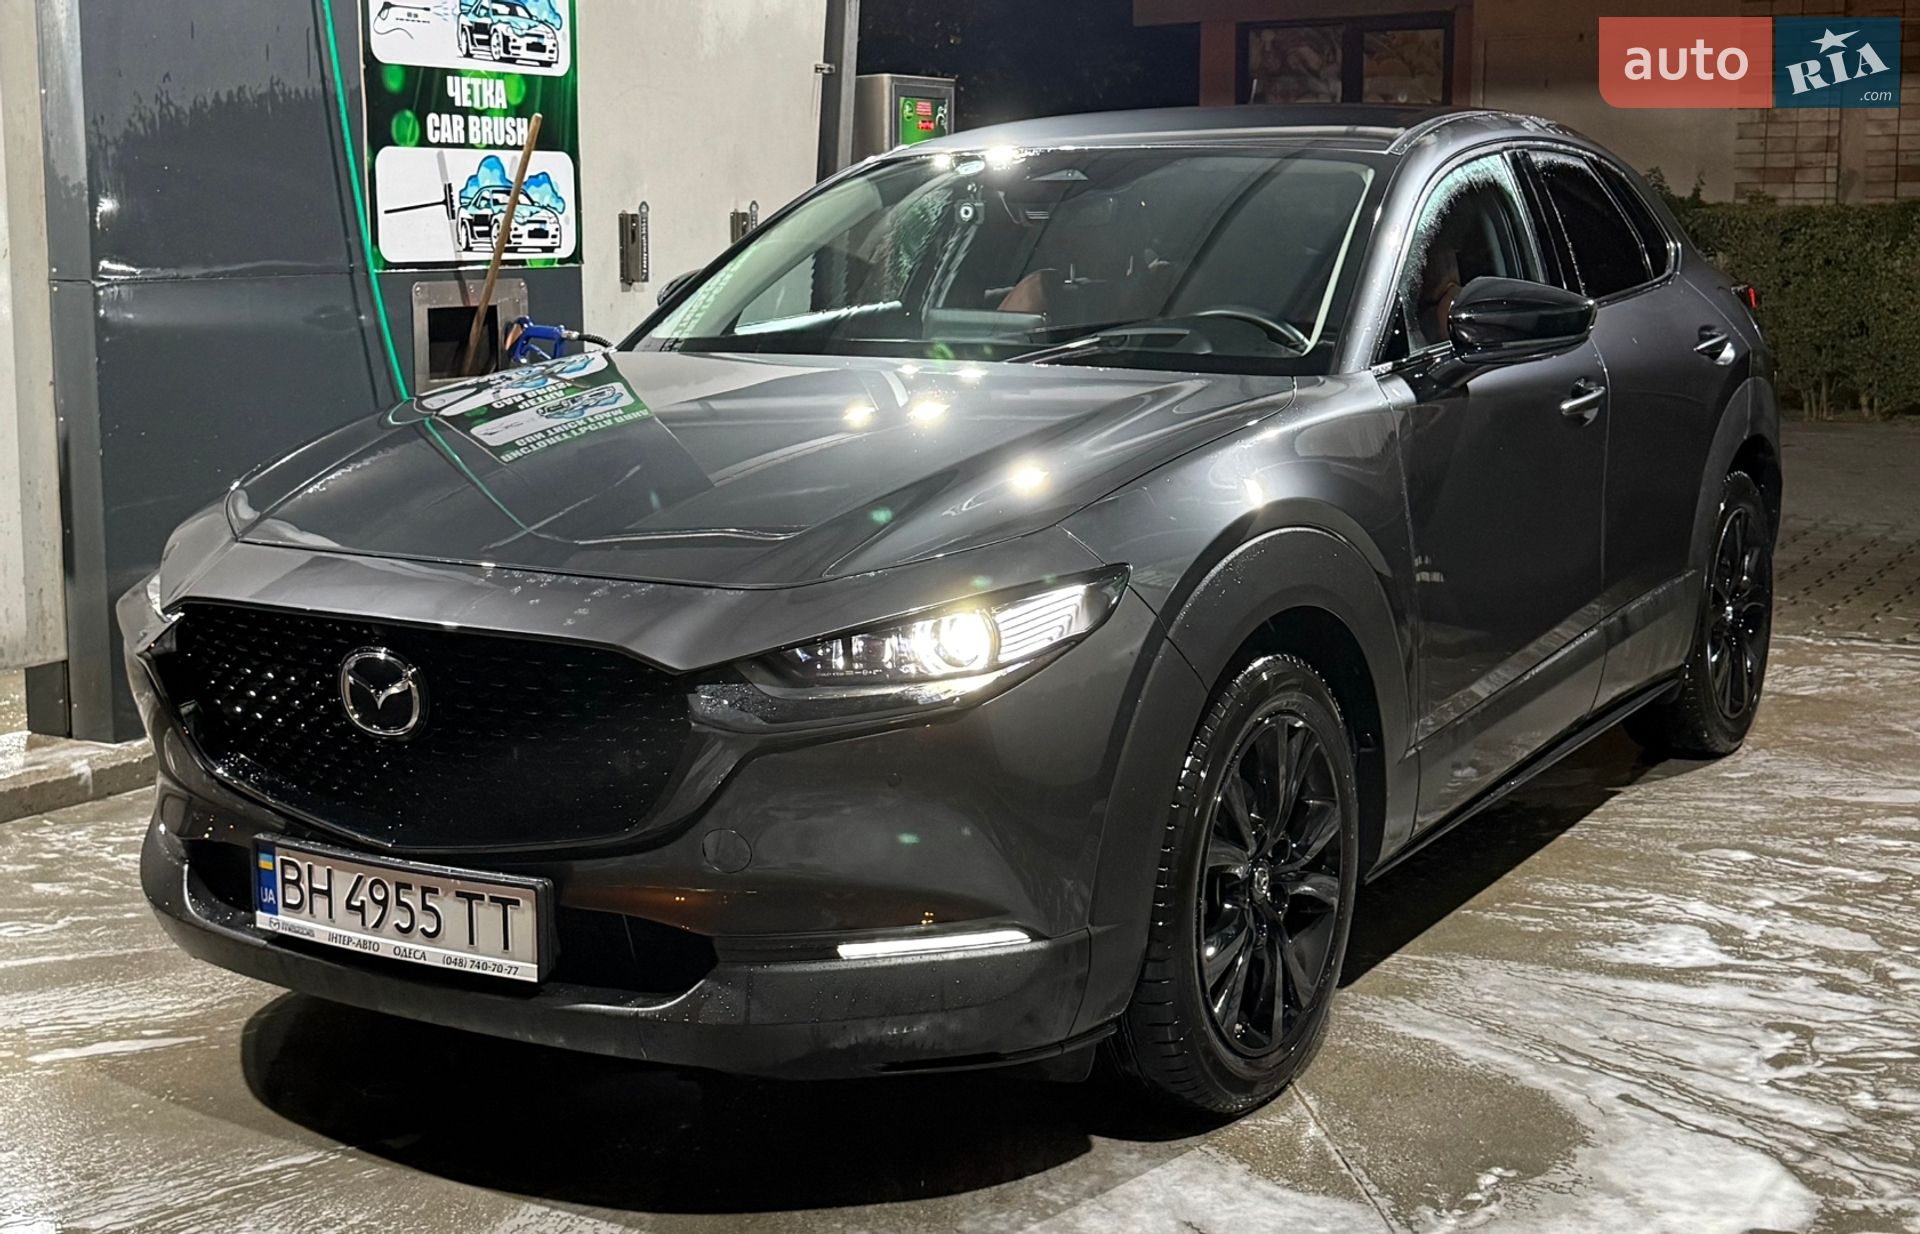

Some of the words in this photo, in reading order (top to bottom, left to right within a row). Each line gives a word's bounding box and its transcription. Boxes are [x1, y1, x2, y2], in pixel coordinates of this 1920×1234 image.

[446, 75, 507, 109] ЧЕТКА
[426, 112, 465, 144] CAR
[468, 116, 529, 146] BRUSH
[260, 887, 276, 904] UA
[279, 857, 333, 920] BH
[345, 873, 442, 938] 4955
[455, 890, 521, 951] TT
[393, 945, 427, 961] ОДЕСА
[442, 955, 467, 969] (048)
[469, 959, 519, 976] 740-70-77
